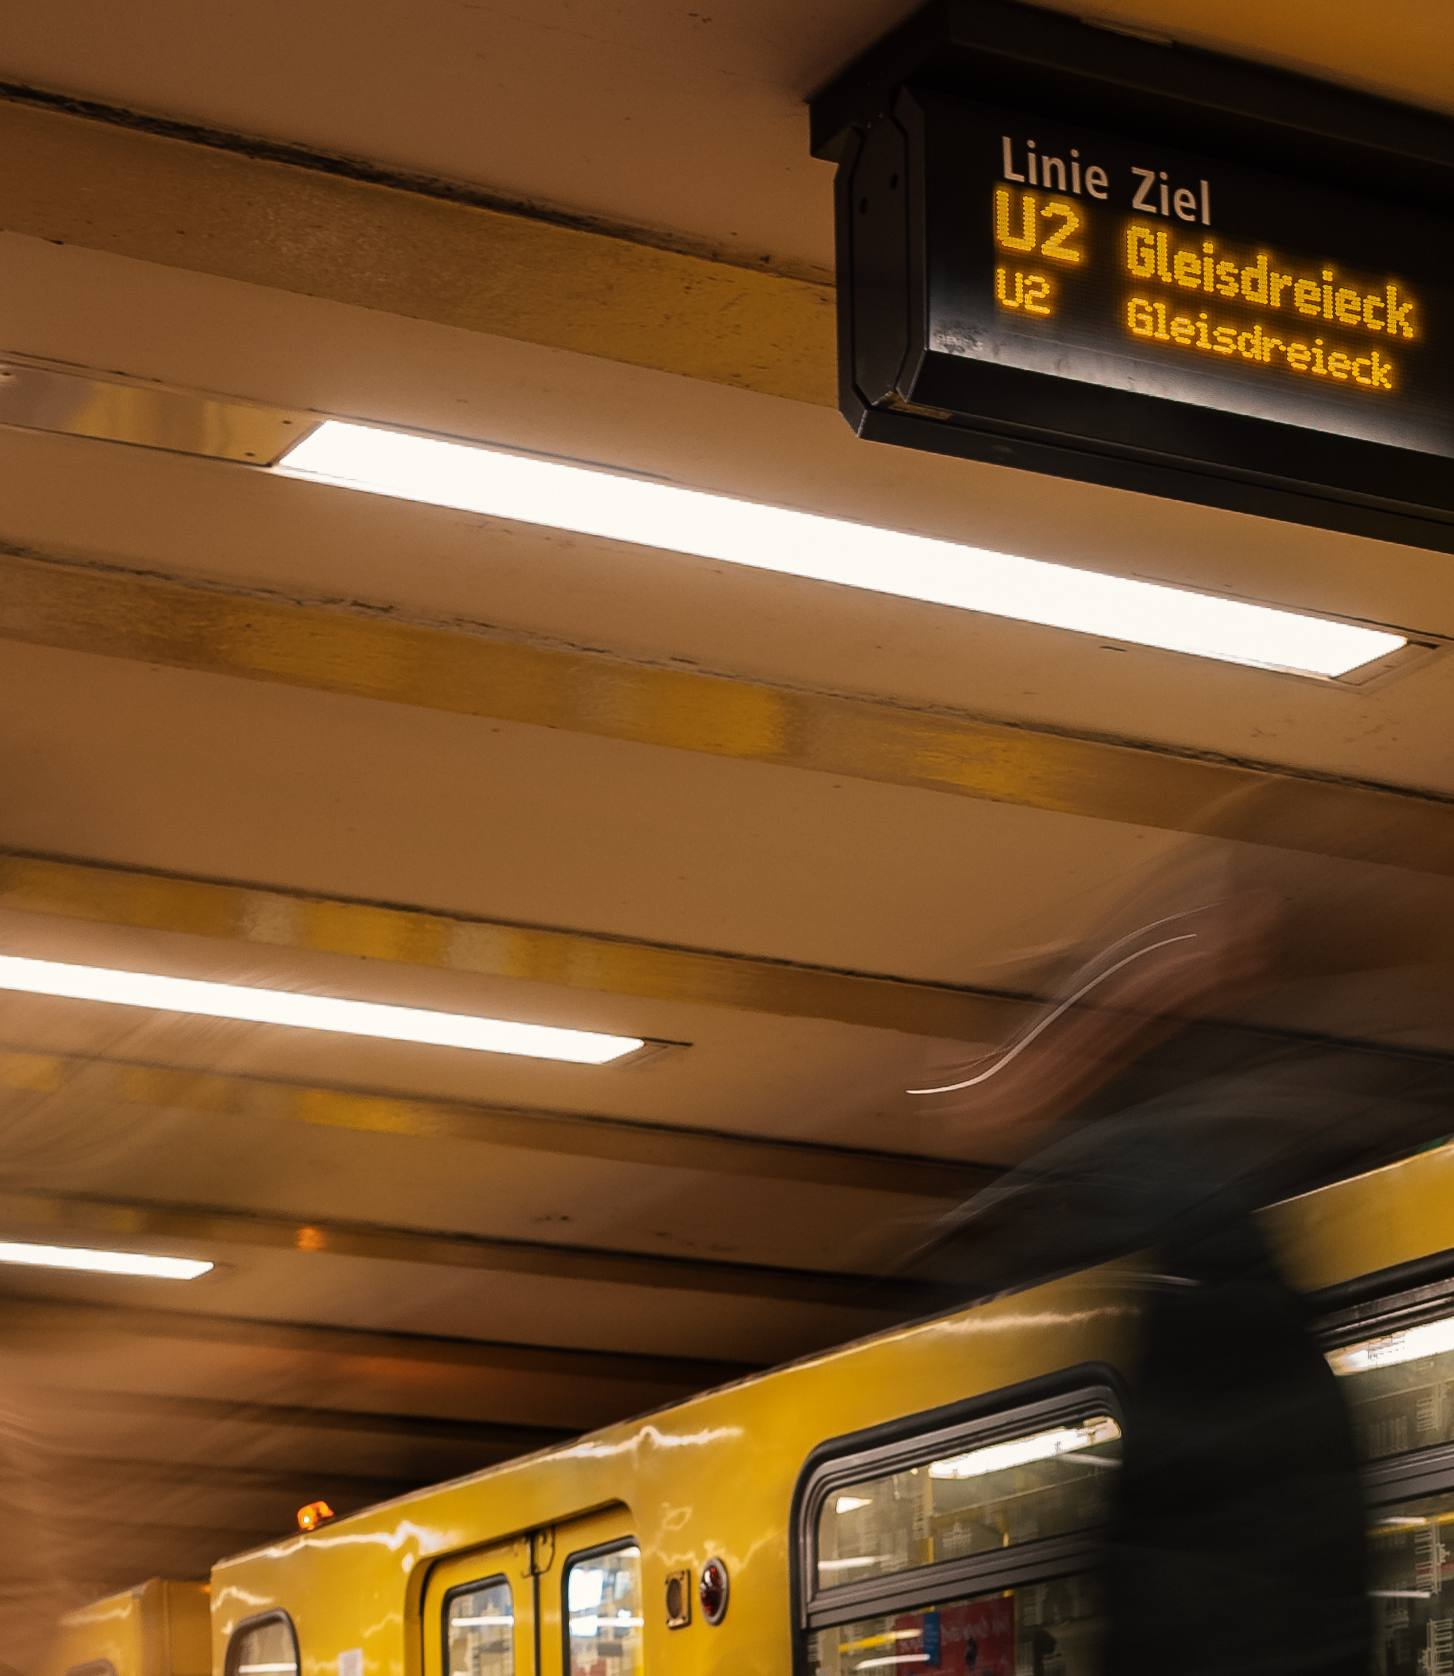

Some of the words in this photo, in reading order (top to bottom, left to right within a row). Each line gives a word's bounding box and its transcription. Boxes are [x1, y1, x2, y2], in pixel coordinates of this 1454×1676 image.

[1002, 136, 1108, 200] Linie
[1132, 167, 1211, 225] Ziel
[996, 190, 1079, 261] U2
[1126, 226, 1413, 338] Gleisdreieck
[997, 268, 1051, 314] U2
[1127, 297, 1392, 390] Gleisdreieck
